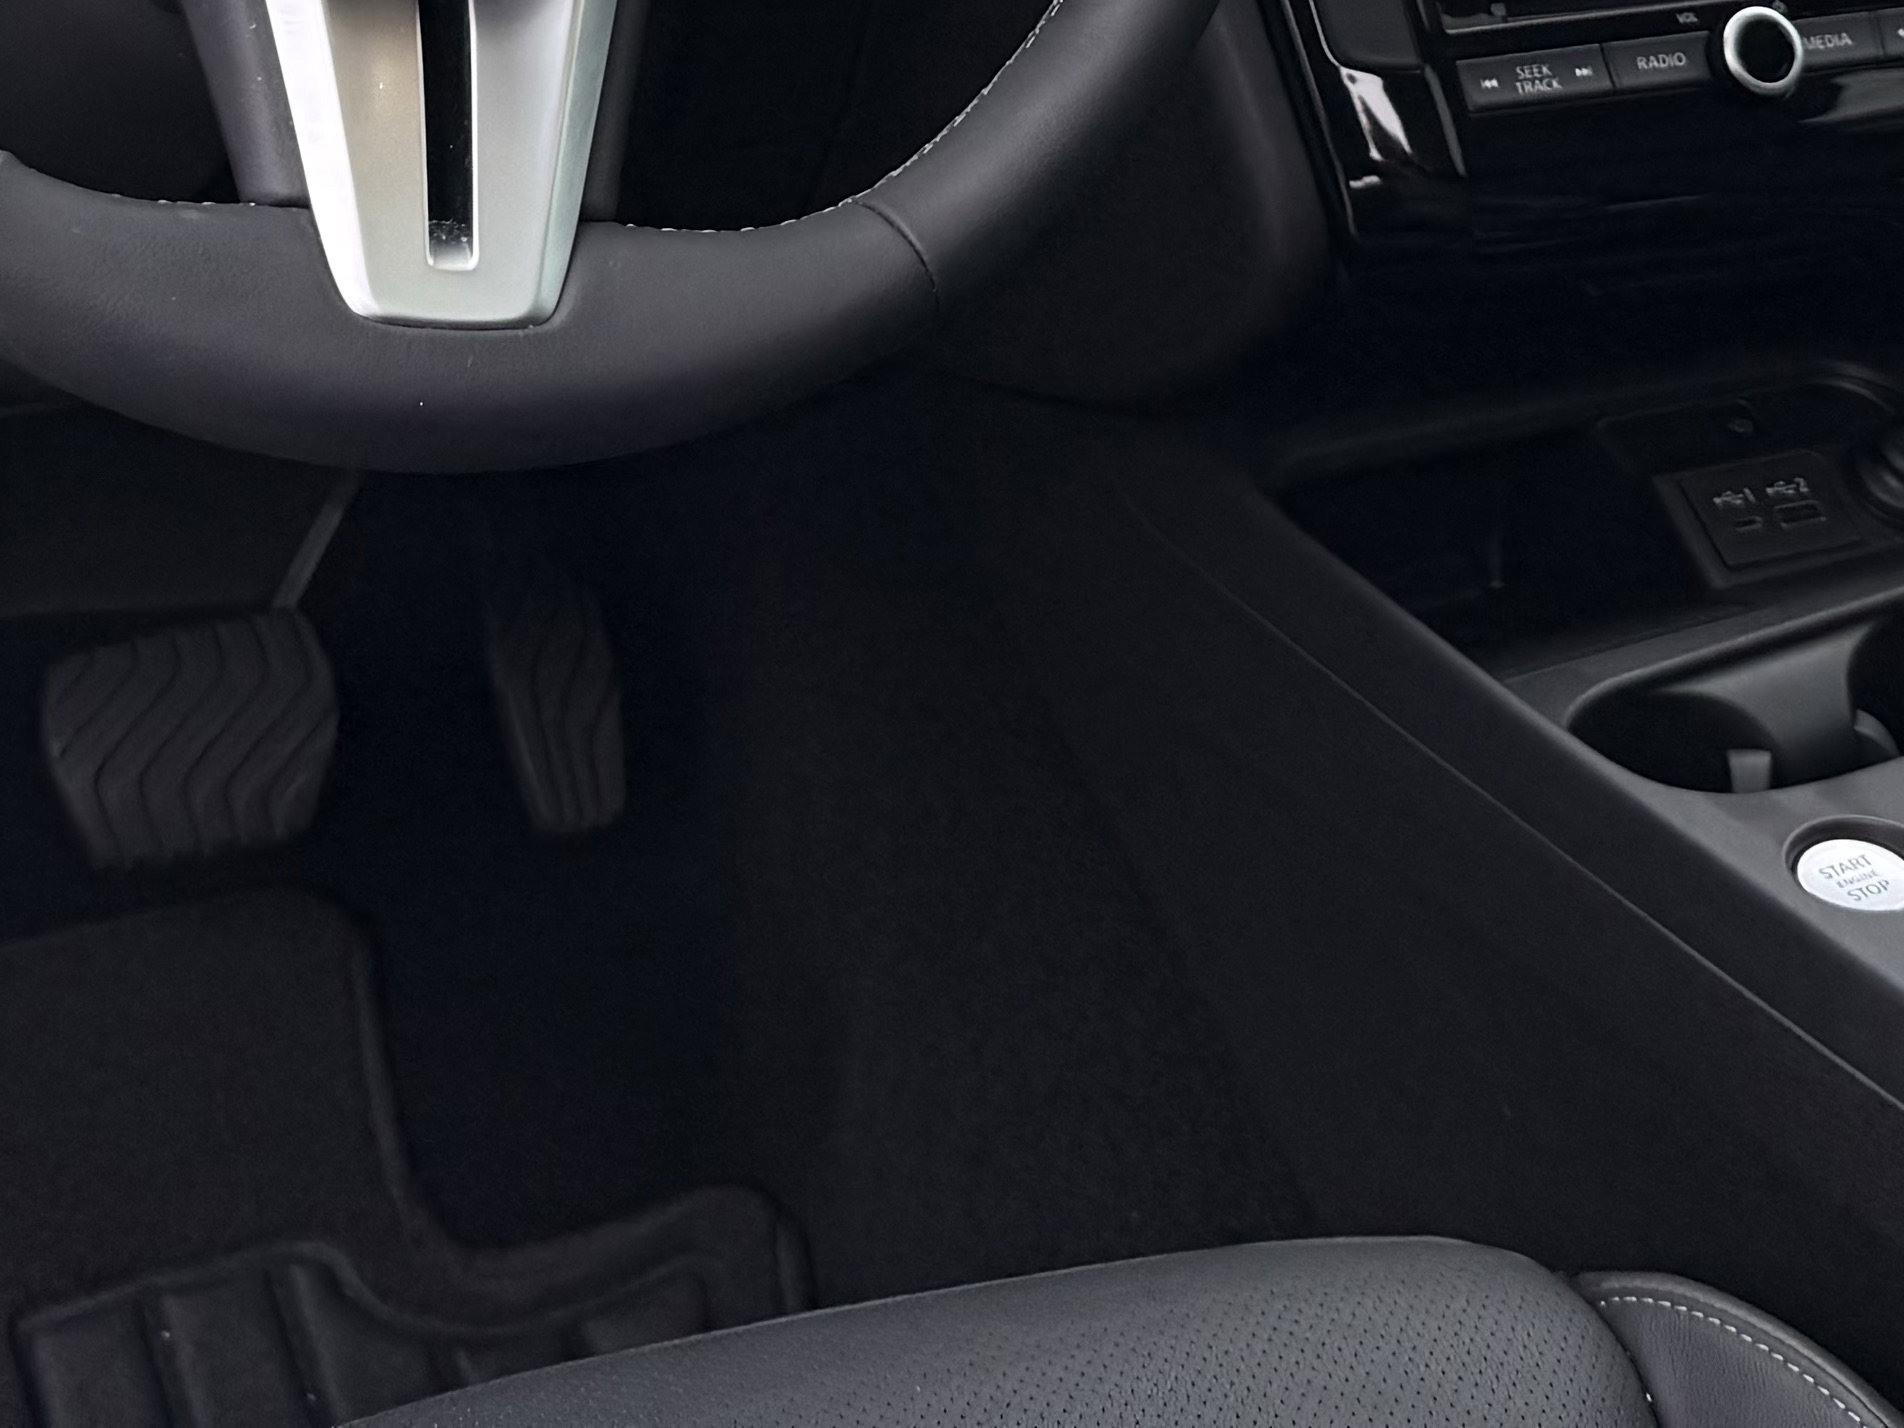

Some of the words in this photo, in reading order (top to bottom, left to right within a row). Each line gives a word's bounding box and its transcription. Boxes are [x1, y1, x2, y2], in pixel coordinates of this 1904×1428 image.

[1676, 12, 1698, 25] VOL
[1637, 51, 1687, 70] RADIO
[1516, 64, 1552, 79] SEEK
[1515, 77, 1562, 94] TRACK
[1819, 854, 1872, 879] START
[1836, 868, 1879, 888] ENGINE
[1847, 879, 1890, 902] STOP
